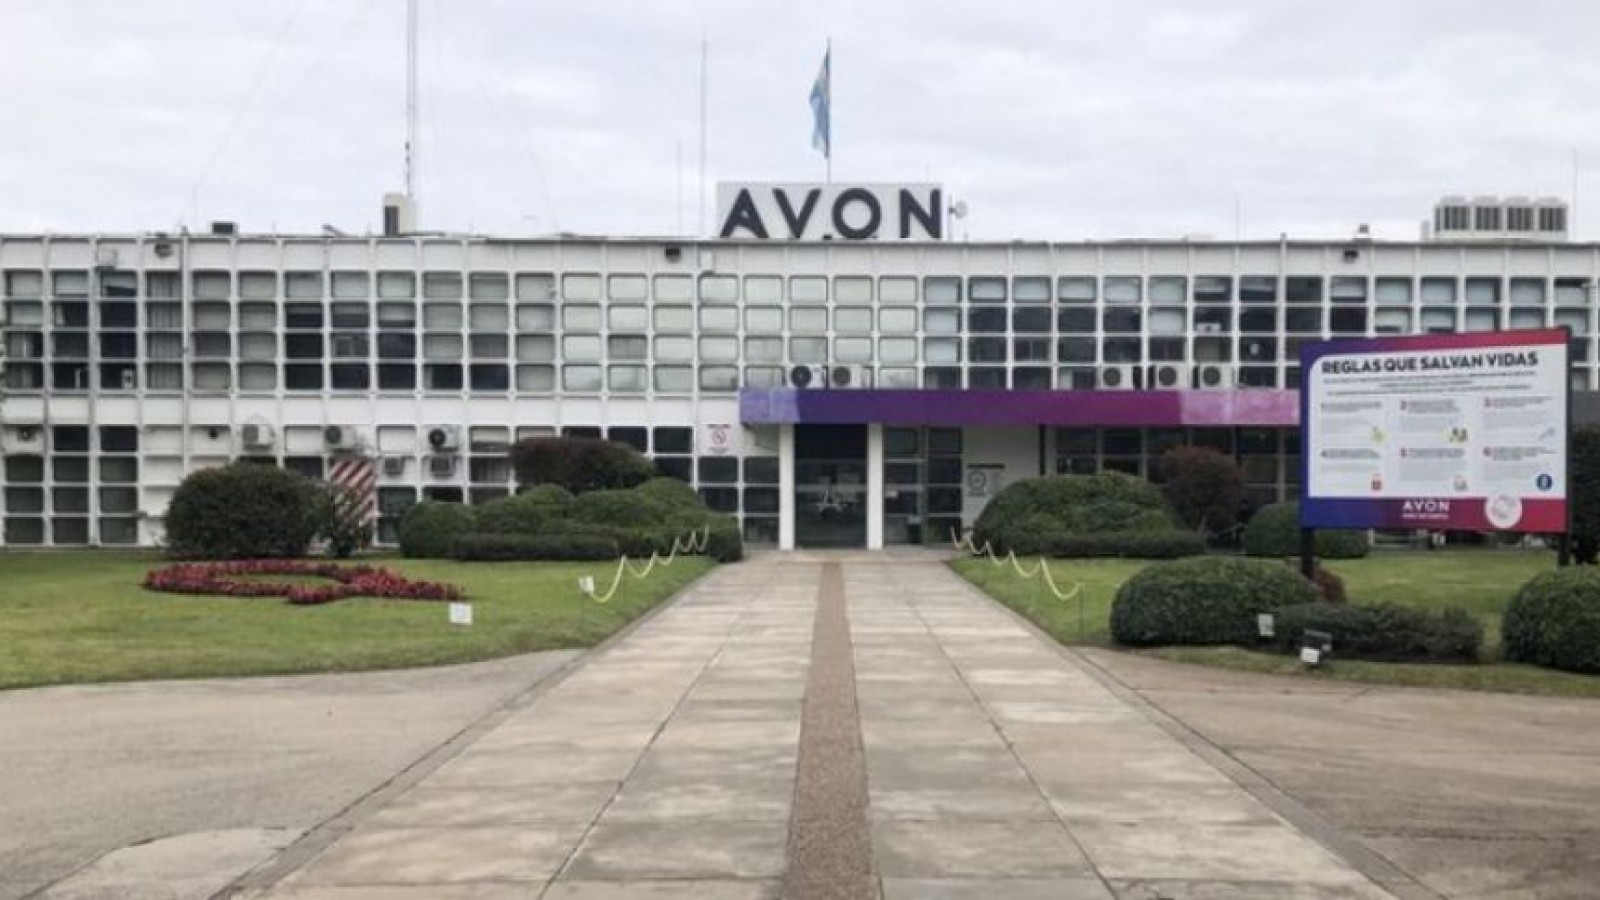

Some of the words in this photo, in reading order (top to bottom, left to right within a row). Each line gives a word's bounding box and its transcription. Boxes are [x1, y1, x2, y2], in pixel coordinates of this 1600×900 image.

[719, 187, 942, 239] AVON
[1322, 359, 1382, 374] REGLAS
[1384, 357, 1417, 372] QUE
[1420, 354, 1483, 370] SALVAN
[1487, 351, 1538, 367] VIDAS
[1402, 501, 1450, 512] AVON
